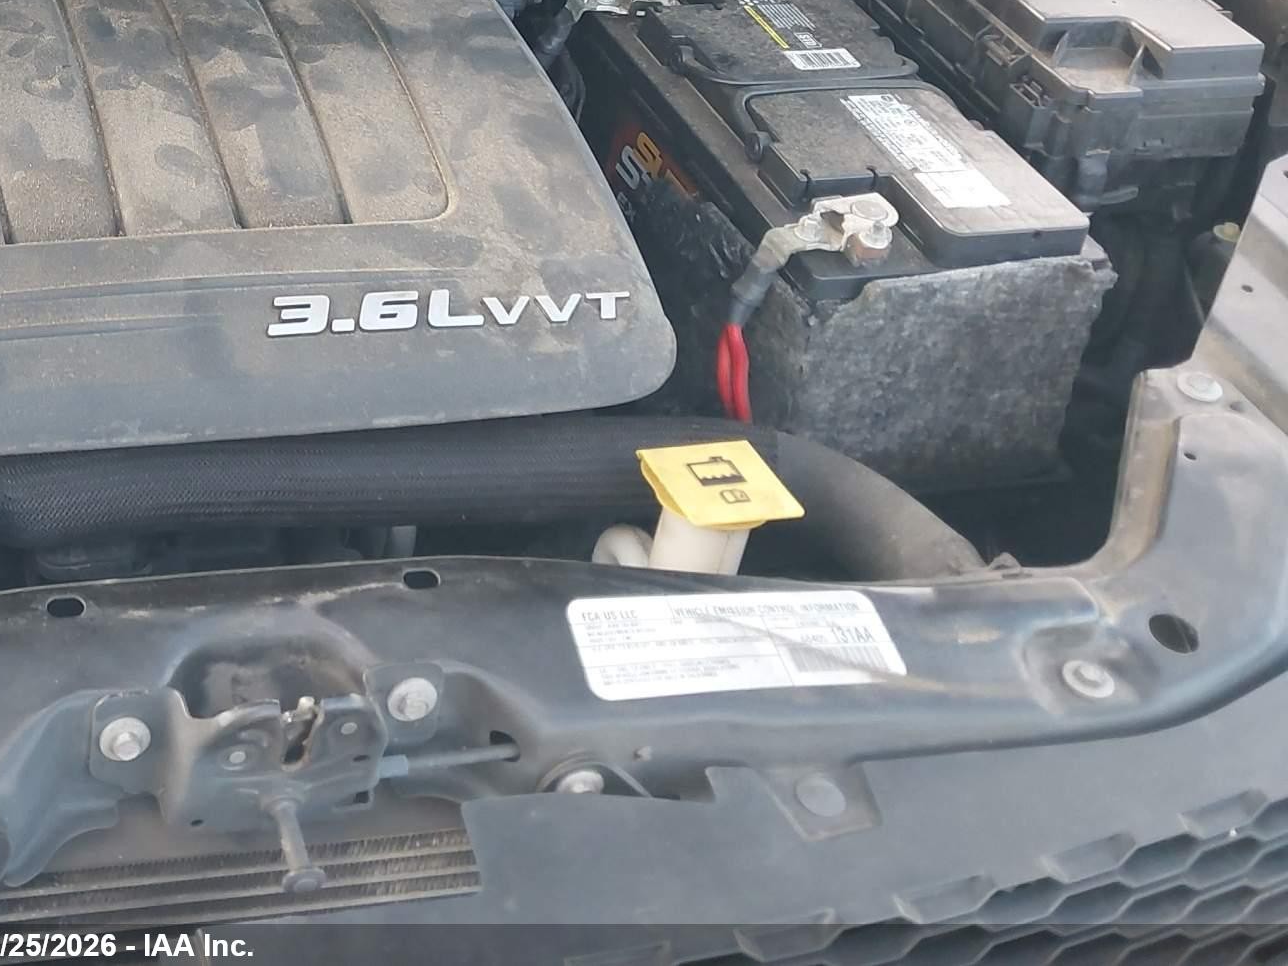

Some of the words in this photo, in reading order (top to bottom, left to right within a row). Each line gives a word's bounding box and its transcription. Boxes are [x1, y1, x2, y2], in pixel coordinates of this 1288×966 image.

[799, 601, 861, 613] INFORMATION
[581, 610, 600, 622] FCA
[603, 610, 617, 621] US
